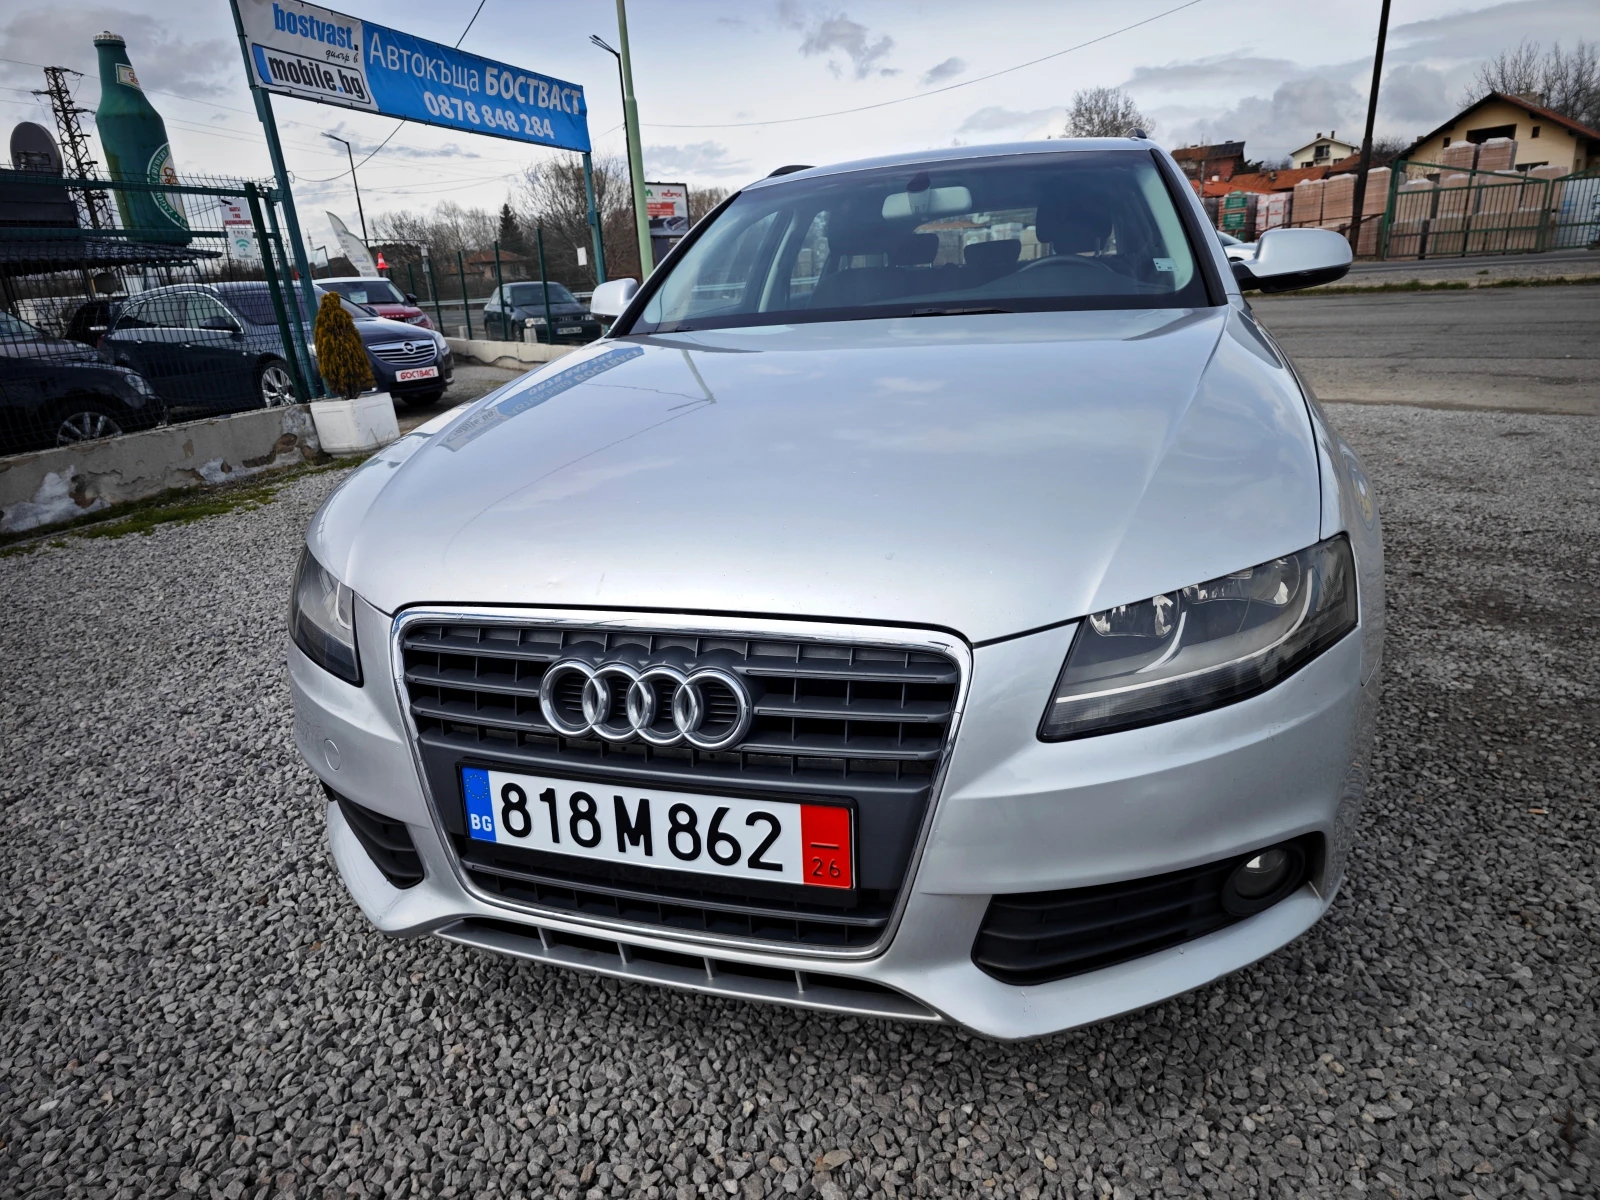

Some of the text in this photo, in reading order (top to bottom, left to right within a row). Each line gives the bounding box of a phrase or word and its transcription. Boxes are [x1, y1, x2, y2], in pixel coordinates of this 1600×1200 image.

[272, 3, 359, 51] bostvast.
[268, 57, 365, 100] mobile.bg
[485, 66, 581, 114] БОСТВАСТ
[423, 91, 555, 139] 0878 848 284
[400, 368, 435, 380] БОСТВАСТ
[470, 813, 493, 832] BG
[667, 803, 784, 873] 862
[812, 856, 842, 878] 26
